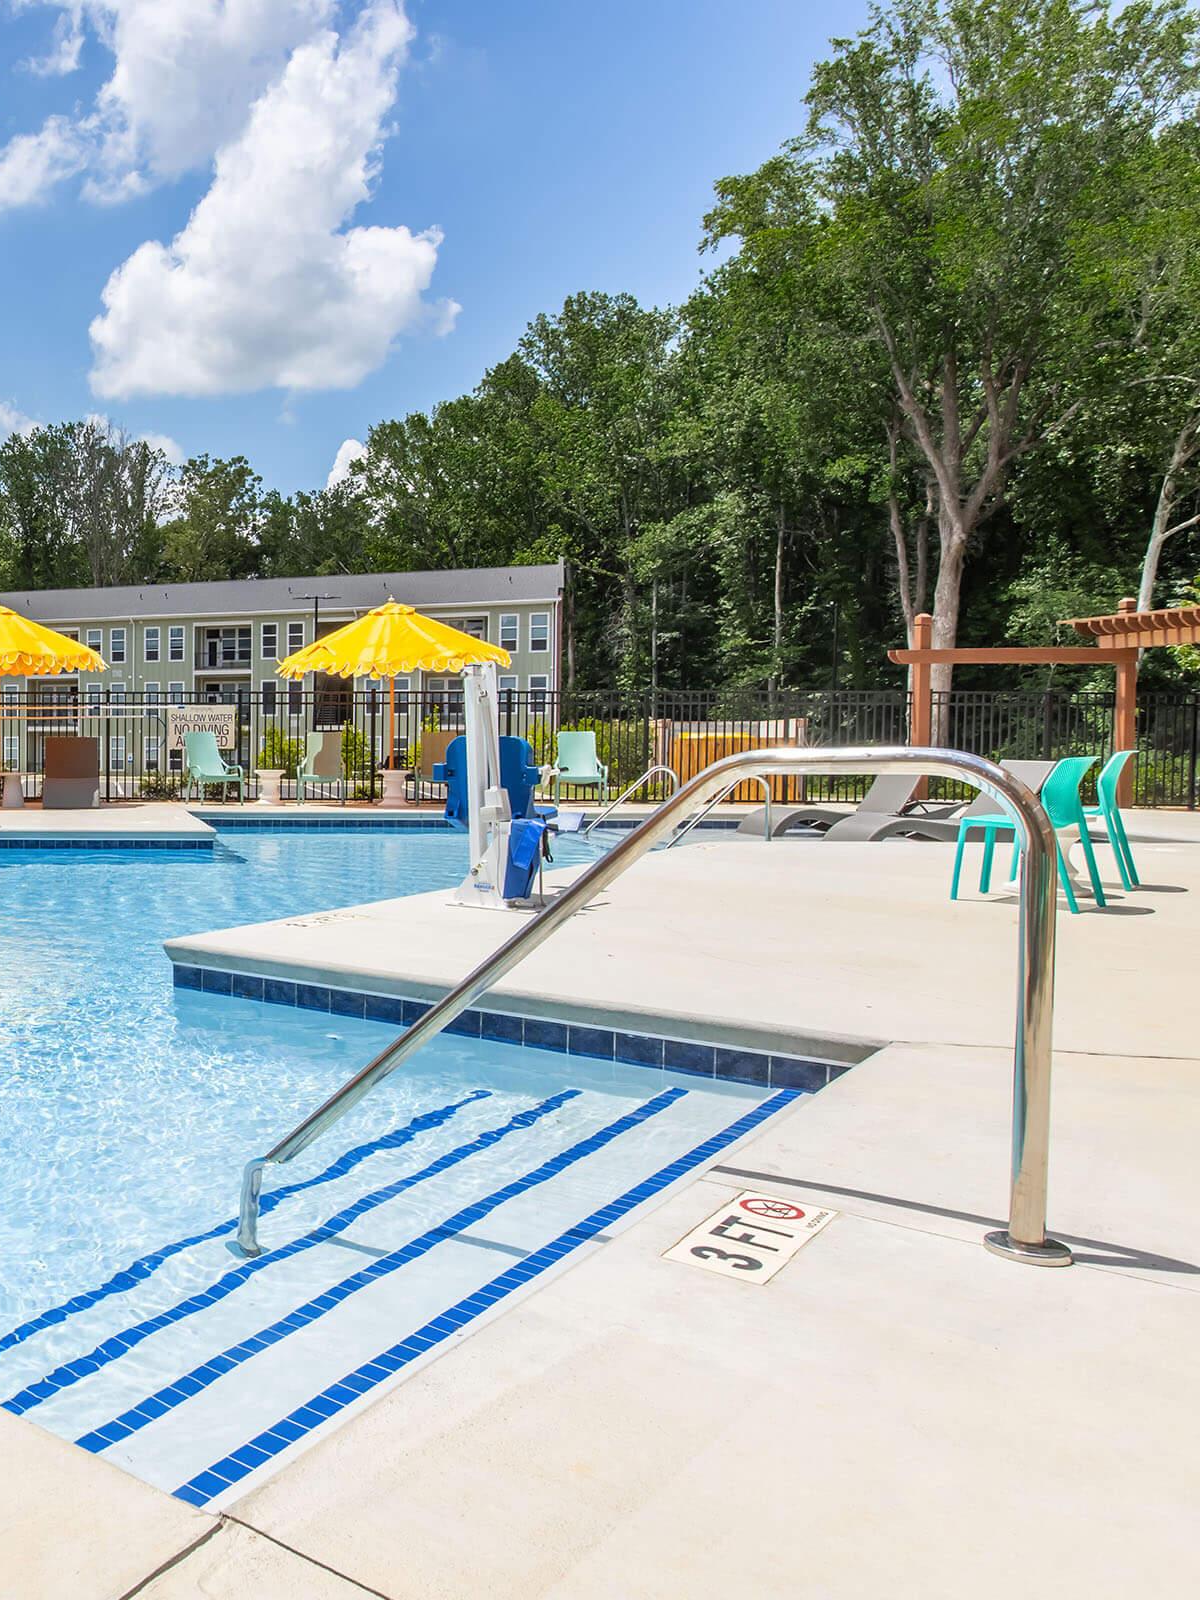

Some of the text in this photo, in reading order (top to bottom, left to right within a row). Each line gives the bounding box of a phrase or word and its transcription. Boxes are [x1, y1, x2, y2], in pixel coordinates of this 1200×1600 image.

[171, 713, 233, 722] SHALLOW WATER
[174, 723, 230, 735] NO DIVING
[690, 1215, 795, 1271] 3 FT
